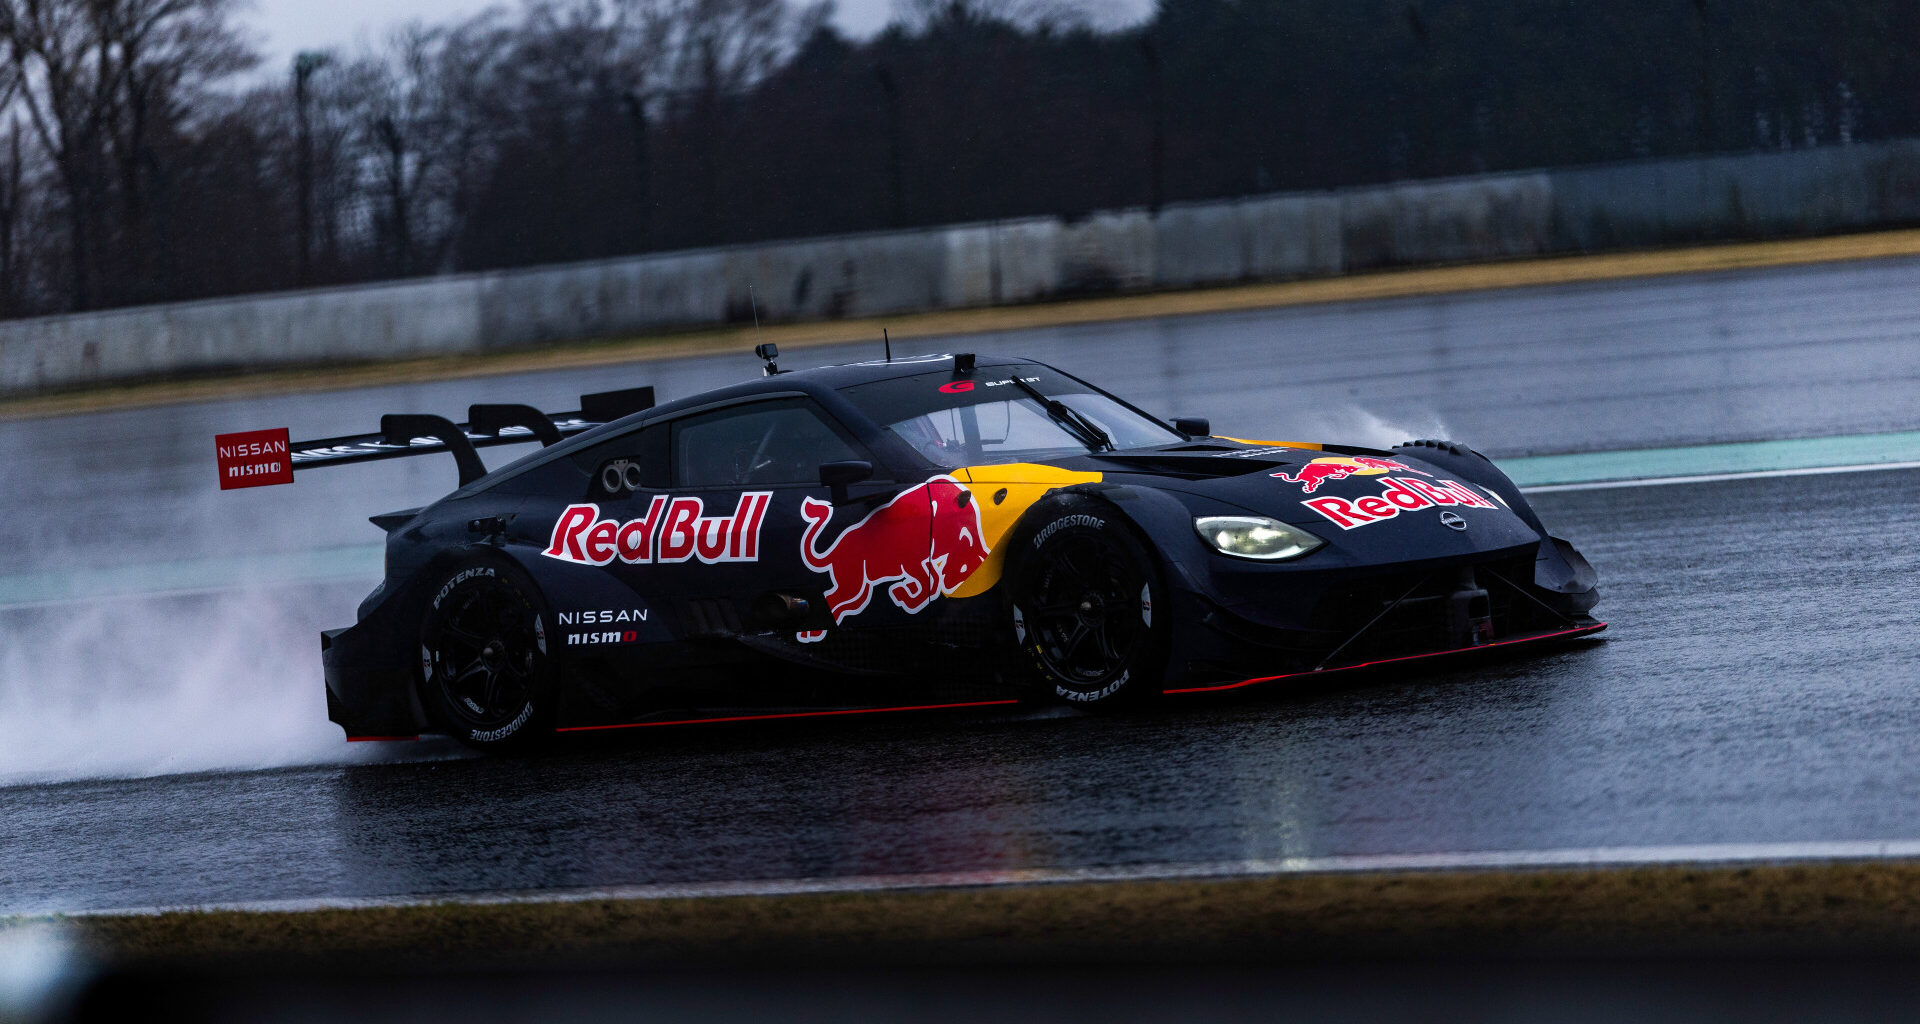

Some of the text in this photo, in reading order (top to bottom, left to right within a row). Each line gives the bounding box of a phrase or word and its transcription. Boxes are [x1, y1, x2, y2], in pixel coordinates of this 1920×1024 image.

[219, 440, 286, 459] NISSAN
[229, 462, 281, 478] nismo
[1301, 477, 1499, 531] Red Bull
[541, 491, 774, 566] Red Bull
[1033, 514, 1106, 550] BRIDGESTONE
[432, 567, 496, 611] POTENZA
[558, 608, 649, 626] NISSAN
[567, 630, 637, 646] nismo
[1056, 668, 1131, 702] POTENZA
[470, 700, 535, 743] BRIDGESTONE
